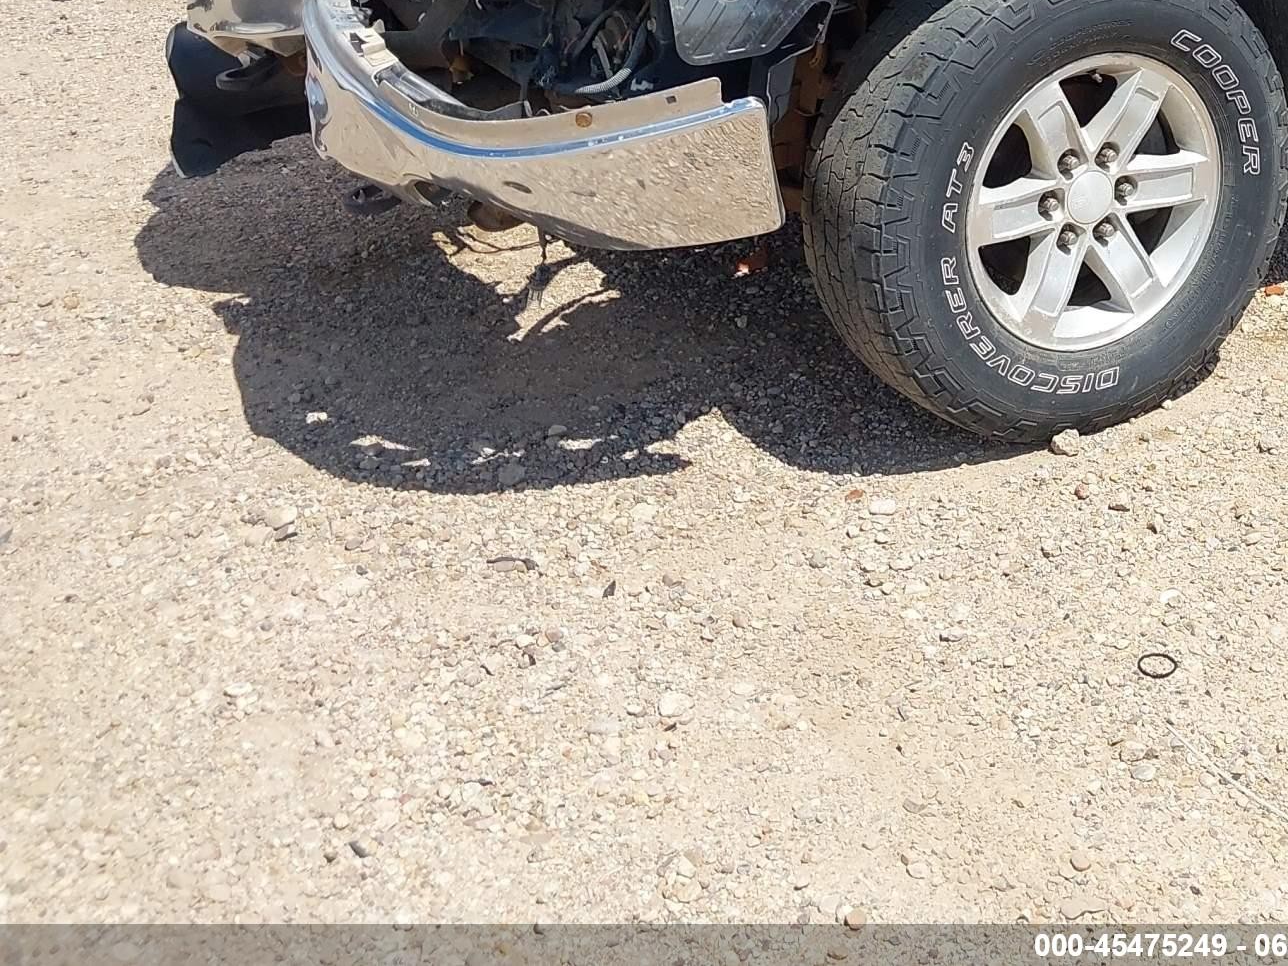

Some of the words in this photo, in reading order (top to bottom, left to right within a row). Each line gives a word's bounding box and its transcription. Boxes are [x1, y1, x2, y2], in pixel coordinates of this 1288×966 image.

[1170, 28, 1261, 176] COOPER
[941, 141, 975, 234] AT3
[941, 256, 1120, 395] DISCOVERER
